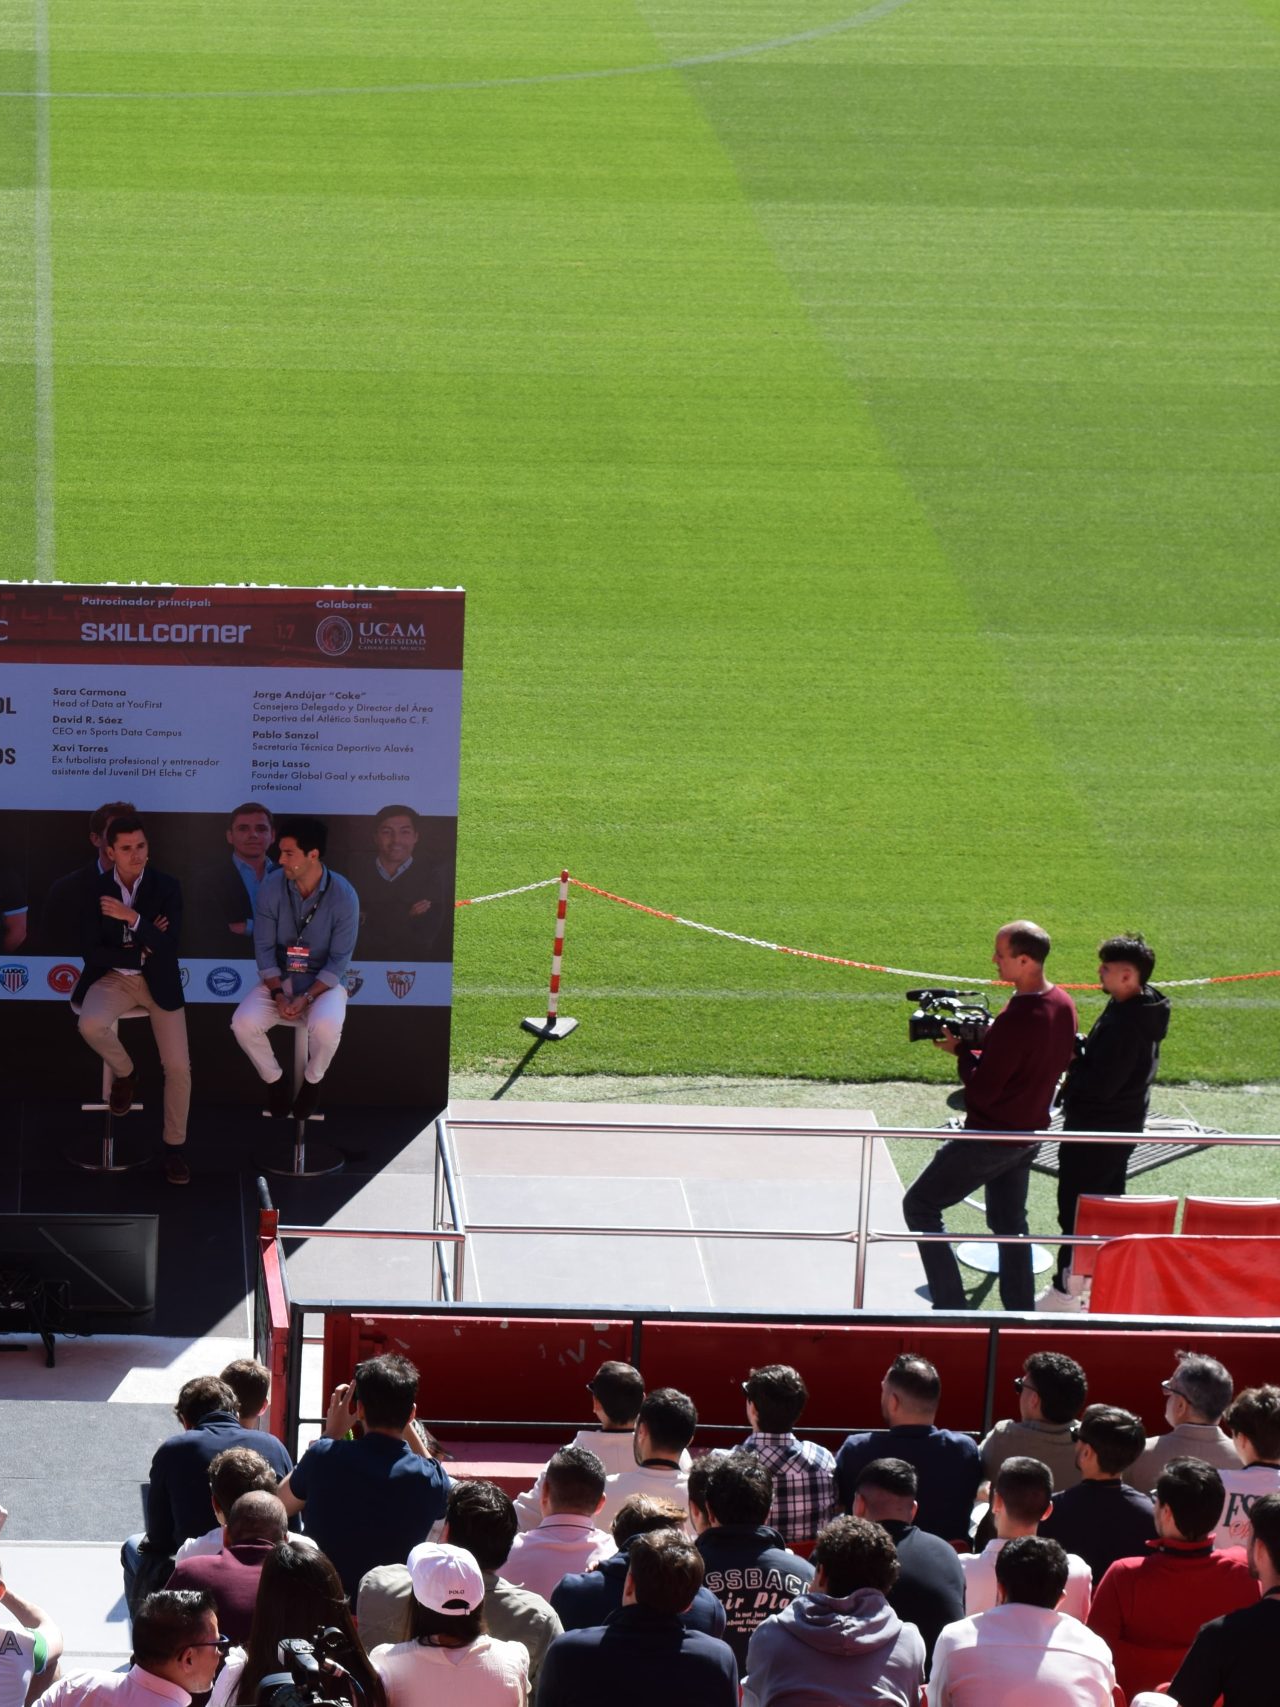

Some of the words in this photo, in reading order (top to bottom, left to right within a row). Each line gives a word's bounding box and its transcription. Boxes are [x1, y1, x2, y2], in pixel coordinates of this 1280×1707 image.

[81, 596, 155, 606] Patrocinador
[158, 598, 211, 608] principal:
[316, 600, 372, 609] Colabora:
[359, 622, 425, 637] UCAM
[53, 688, 76, 696] Sara
[79, 688, 127, 697] Carmona
[253, 690, 281, 700] Jorge
[284, 691, 326, 701] Andújar
[53, 699, 77, 708] Head
[80, 699, 89, 708] of
[91, 700, 113, 708] Data
[116, 700, 125, 708] at
[128, 700, 162, 709] YouFirst
[253, 702, 299, 712] Consejero
[301, 703, 345, 713] Delegado
[356, 703, 392, 712] Director
[395, 704, 409, 713] del
[411, 702, 433, 713] Área
[52, 715, 83, 724] David
[86, 716, 95, 724] R.
[98, 716, 123, 724] Sáez
[253, 714, 297, 724] Deportiva
[300, 714, 314, 723] del
[317, 714, 351, 723] Atlético
[353, 715, 407, 725] Sanluqueño
[52, 727, 73, 736] CEO
[90, 728, 118, 737] Sports
[121, 728, 143, 736] Data
[145, 728, 182, 738] Campus
[252, 731, 281, 739] Pablo
[284, 731, 319, 740] Sanzol
[52, 744, 75, 752] Xavi
[78, 744, 109, 753] Torres
[301, 743, 333, 752] Técnica
[336, 744, 381, 754] Deportivo
[384, 745, 414, 753] Alavés
[52, 756, 63, 764] Ex
[66, 755, 106, 765] futbolista
[109, 756, 159, 767] profesional
[170, 757, 219, 766] entrenador
[252, 760, 279, 769] Borja
[282, 760, 310, 768] Lasso
[52, 768, 90, 776] asistente
[93, 768, 106, 776] del
[108, 768, 139, 776] Juvenil
[159, 769, 182, 777] Elche
[185, 769, 197, 777] CF
[251, 771, 288, 780] Founder
[291, 771, 322, 780] Global
[325, 772, 348, 780] Goal
[358, 772, 410, 781] exfutbolista
[251, 783, 302, 792] profesional
